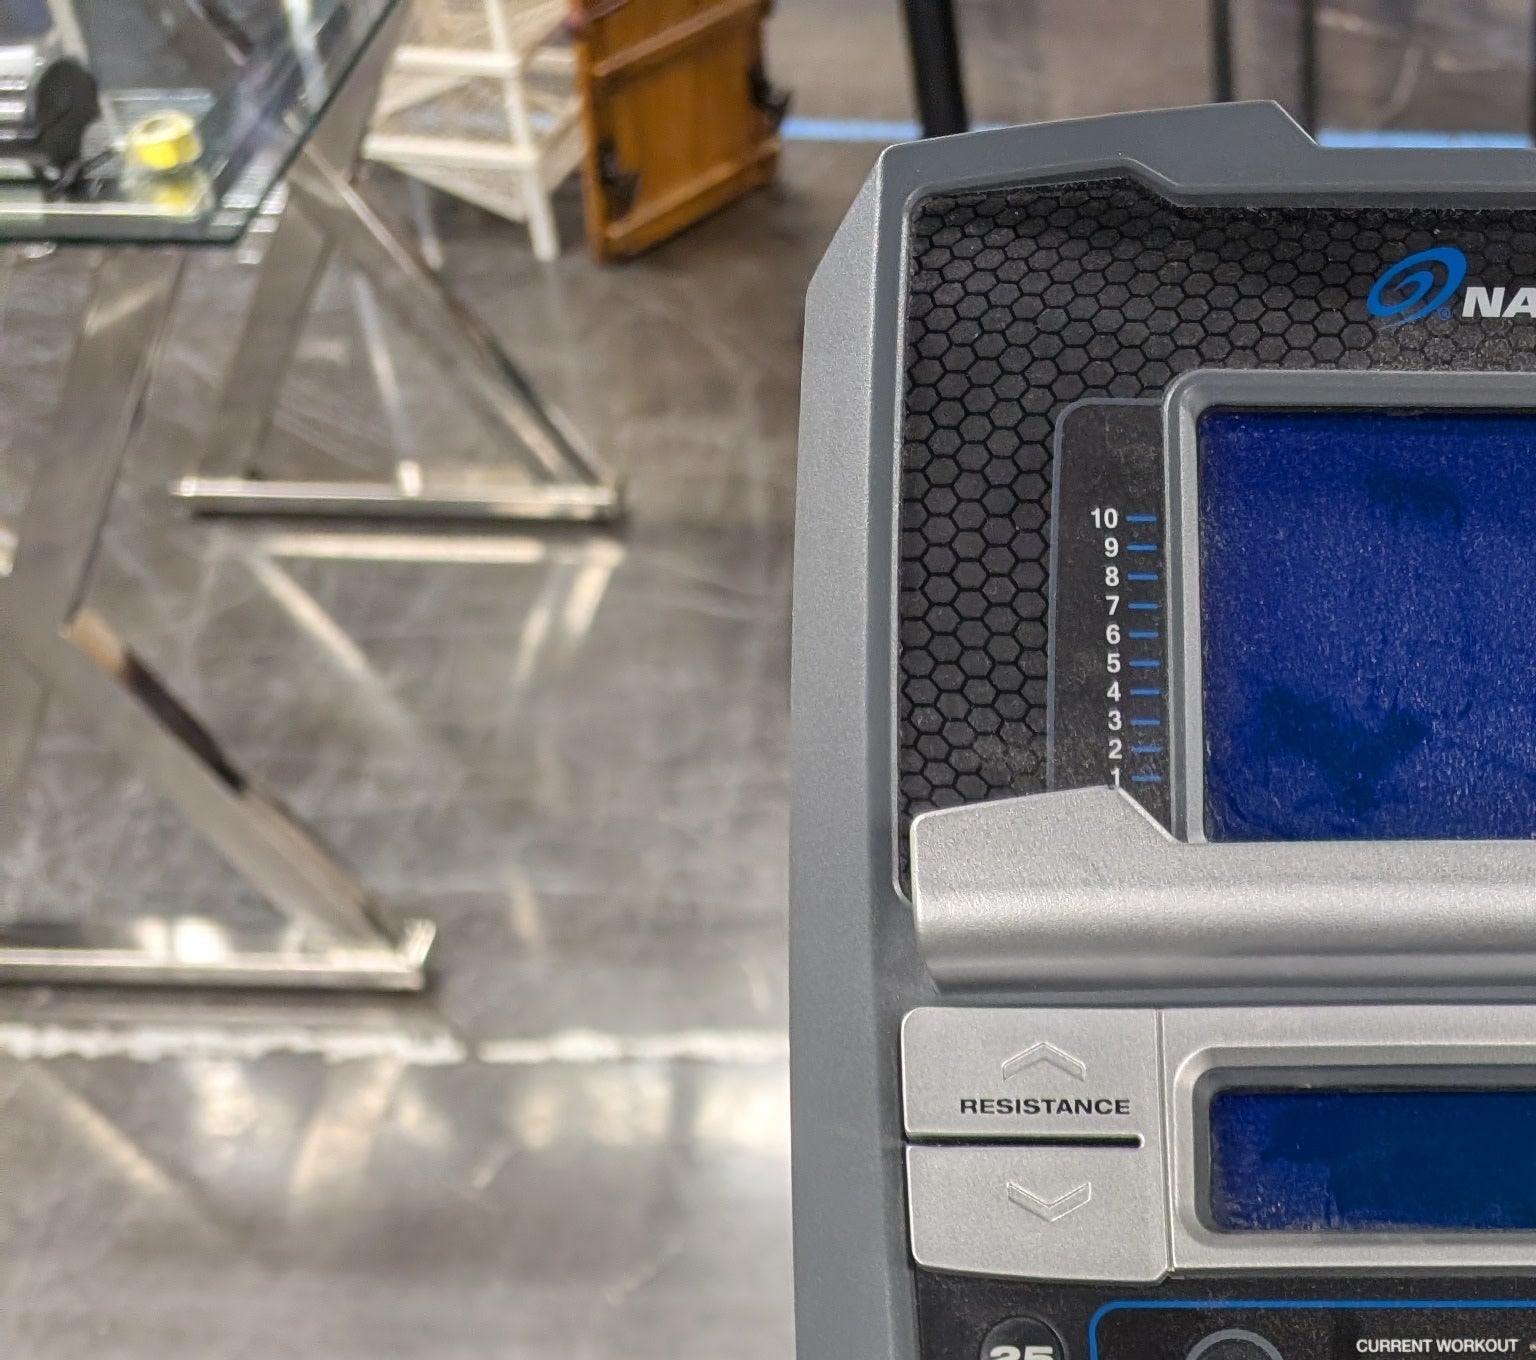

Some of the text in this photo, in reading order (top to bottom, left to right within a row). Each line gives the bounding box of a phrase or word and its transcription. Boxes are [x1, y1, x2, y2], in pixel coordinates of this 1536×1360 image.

[1090, 507, 1118, 529] 10
[1104, 537, 1119, 558] 9
[1105, 565, 1120, 587] 8
[1105, 595, 1120, 616] 7
[1105, 623, 1121, 645] 6
[1107, 652, 1121, 673] 5
[1106, 680, 1122, 702] 4
[1108, 709, 1122, 731] 3
[1108, 738, 1123, 760] 2
[1110, 768, 1121, 787] 1
[960, 1098, 1130, 1115] RESISTANCE
[1356, 1338, 1519, 1353] CURRENT WORKOUT
